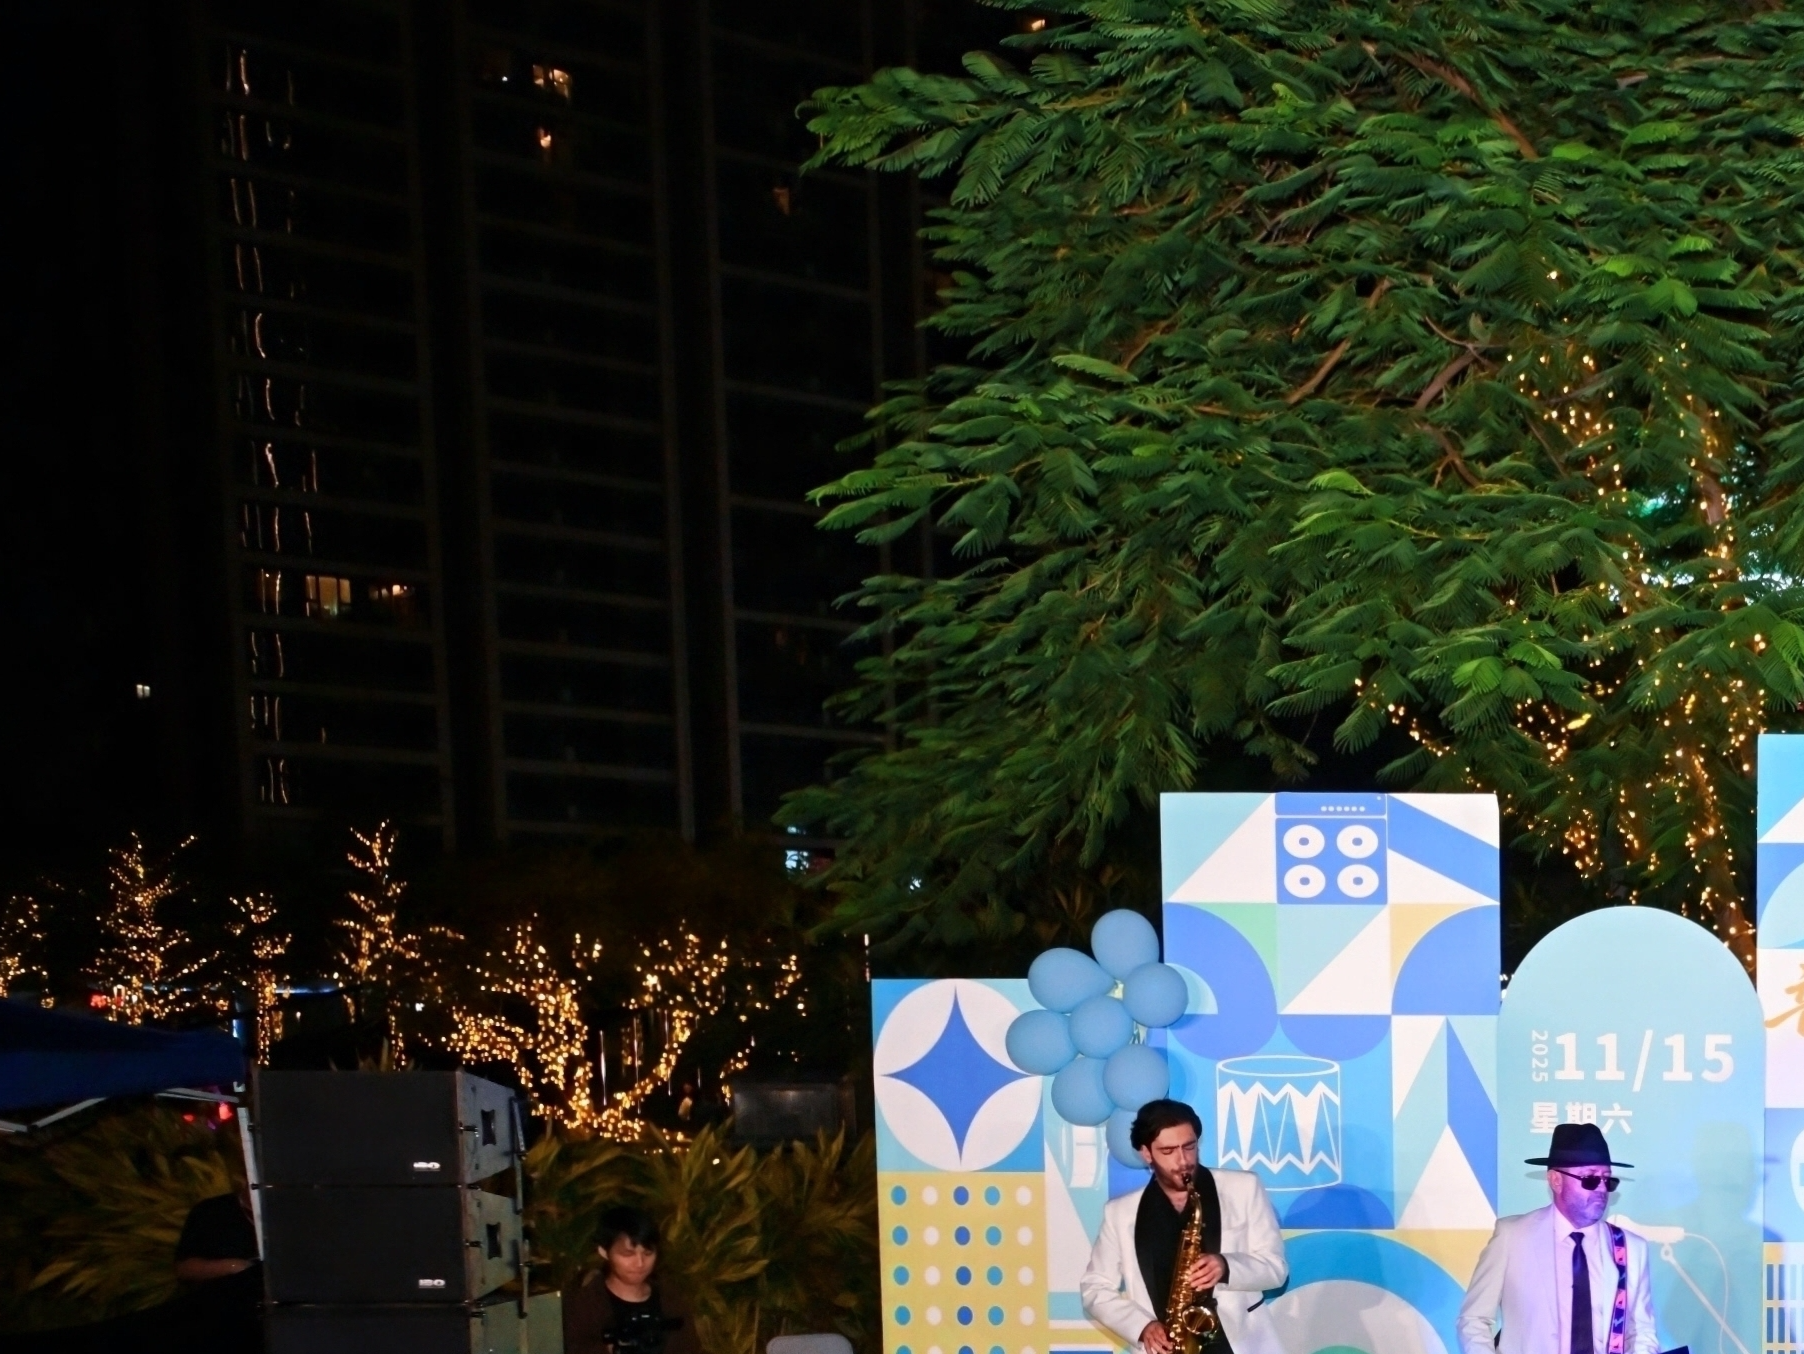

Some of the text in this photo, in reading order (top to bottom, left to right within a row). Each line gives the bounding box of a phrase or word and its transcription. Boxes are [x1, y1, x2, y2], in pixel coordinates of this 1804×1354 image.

[1531, 1029, 1549, 1083] 2025
[1554, 1029, 1735, 1092] 11/15
[1529, 1101, 1633, 1135] 星期六
